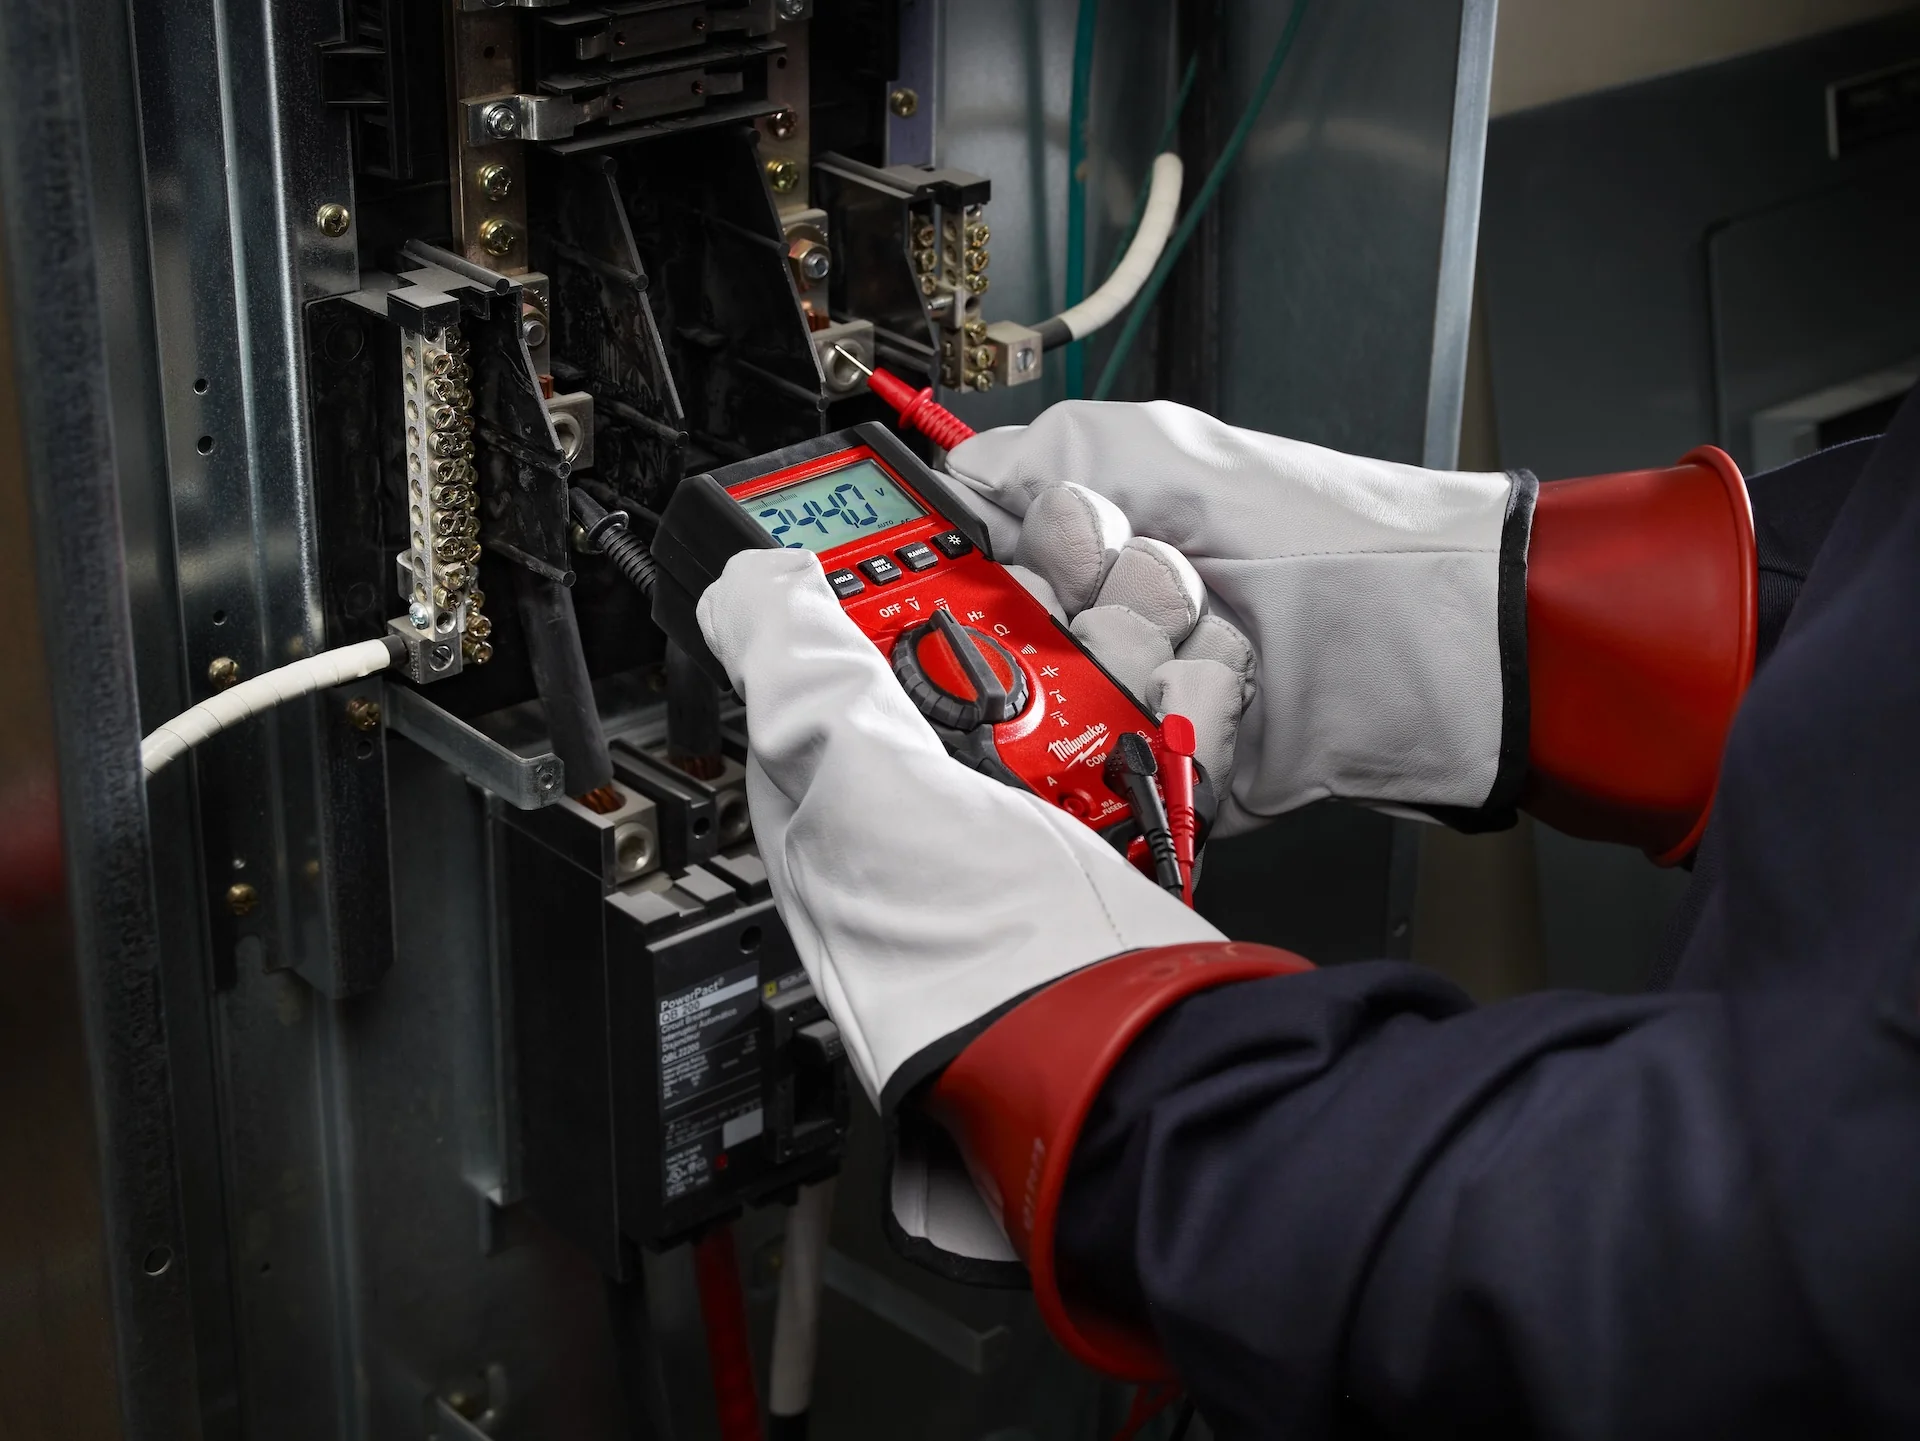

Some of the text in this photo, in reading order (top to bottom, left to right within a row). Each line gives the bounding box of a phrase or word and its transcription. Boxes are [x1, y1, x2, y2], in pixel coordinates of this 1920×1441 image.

[875, 488, 885, 497] V
[877, 519, 894, 529] AUTO
[907, 547, 929, 558] RANGE
[871, 558, 887, 568] MIN
[875, 563, 893, 573] MAX
[834, 573, 854, 585] HOLD
[879, 603, 901, 618] OFF
[967, 611, 985, 622] Hz
[1047, 722, 1108, 762] Milwaukee
[1085, 752, 1107, 767] COM
[1046, 775, 1058, 786] A
[1102, 802, 1123, 816] FUSED
[661, 1000, 700, 1023] QB 200
